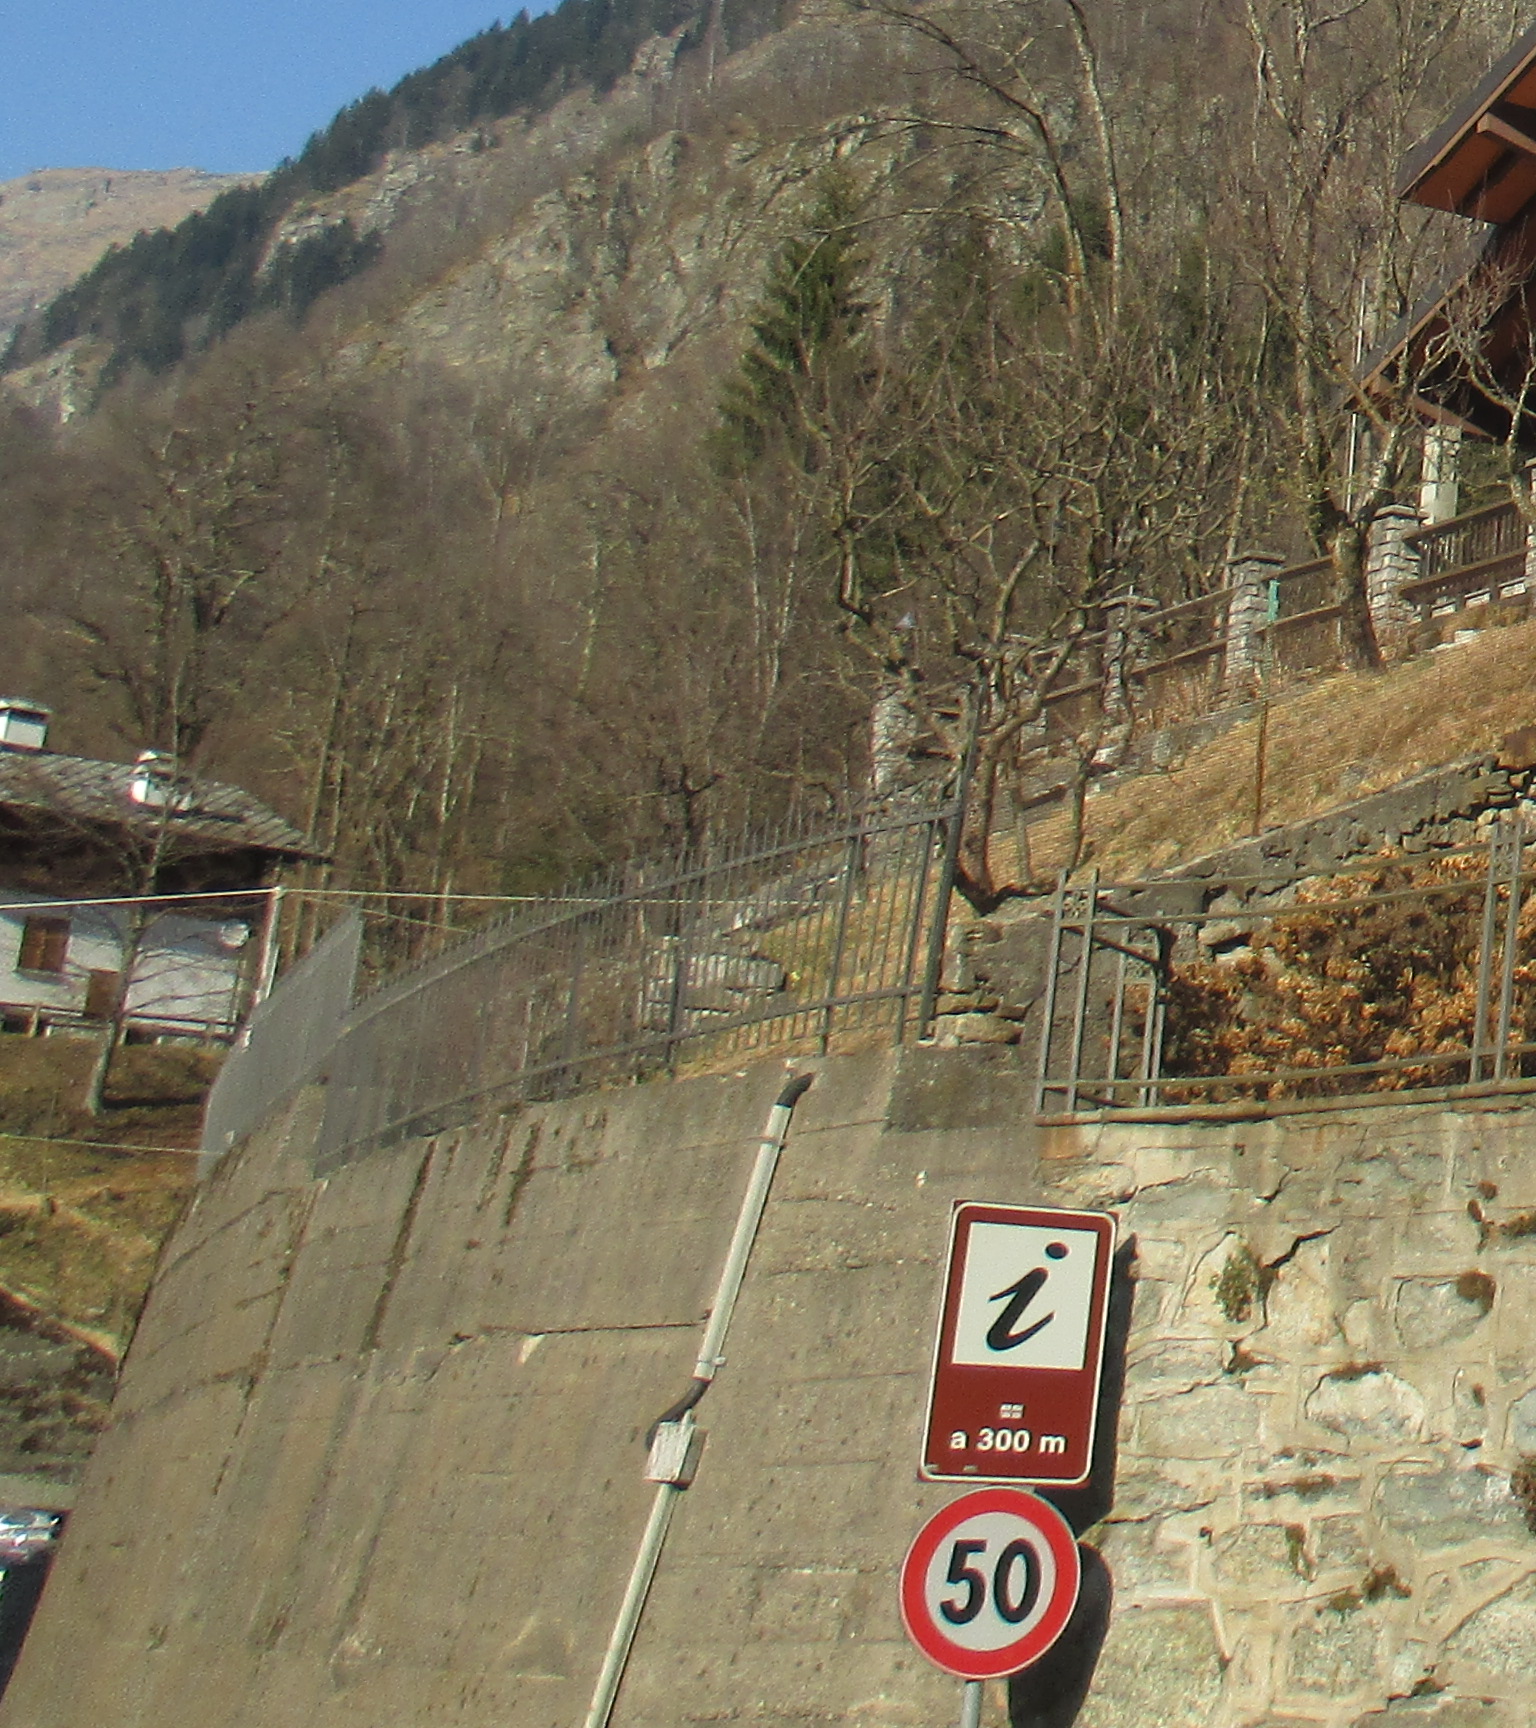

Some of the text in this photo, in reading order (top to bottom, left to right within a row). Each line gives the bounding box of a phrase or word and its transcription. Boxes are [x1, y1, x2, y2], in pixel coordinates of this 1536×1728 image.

[987, 1241, 1069, 1351] i
[950, 1427, 1066, 1454] a 300 m
[939, 1538, 1042, 1625] 50
